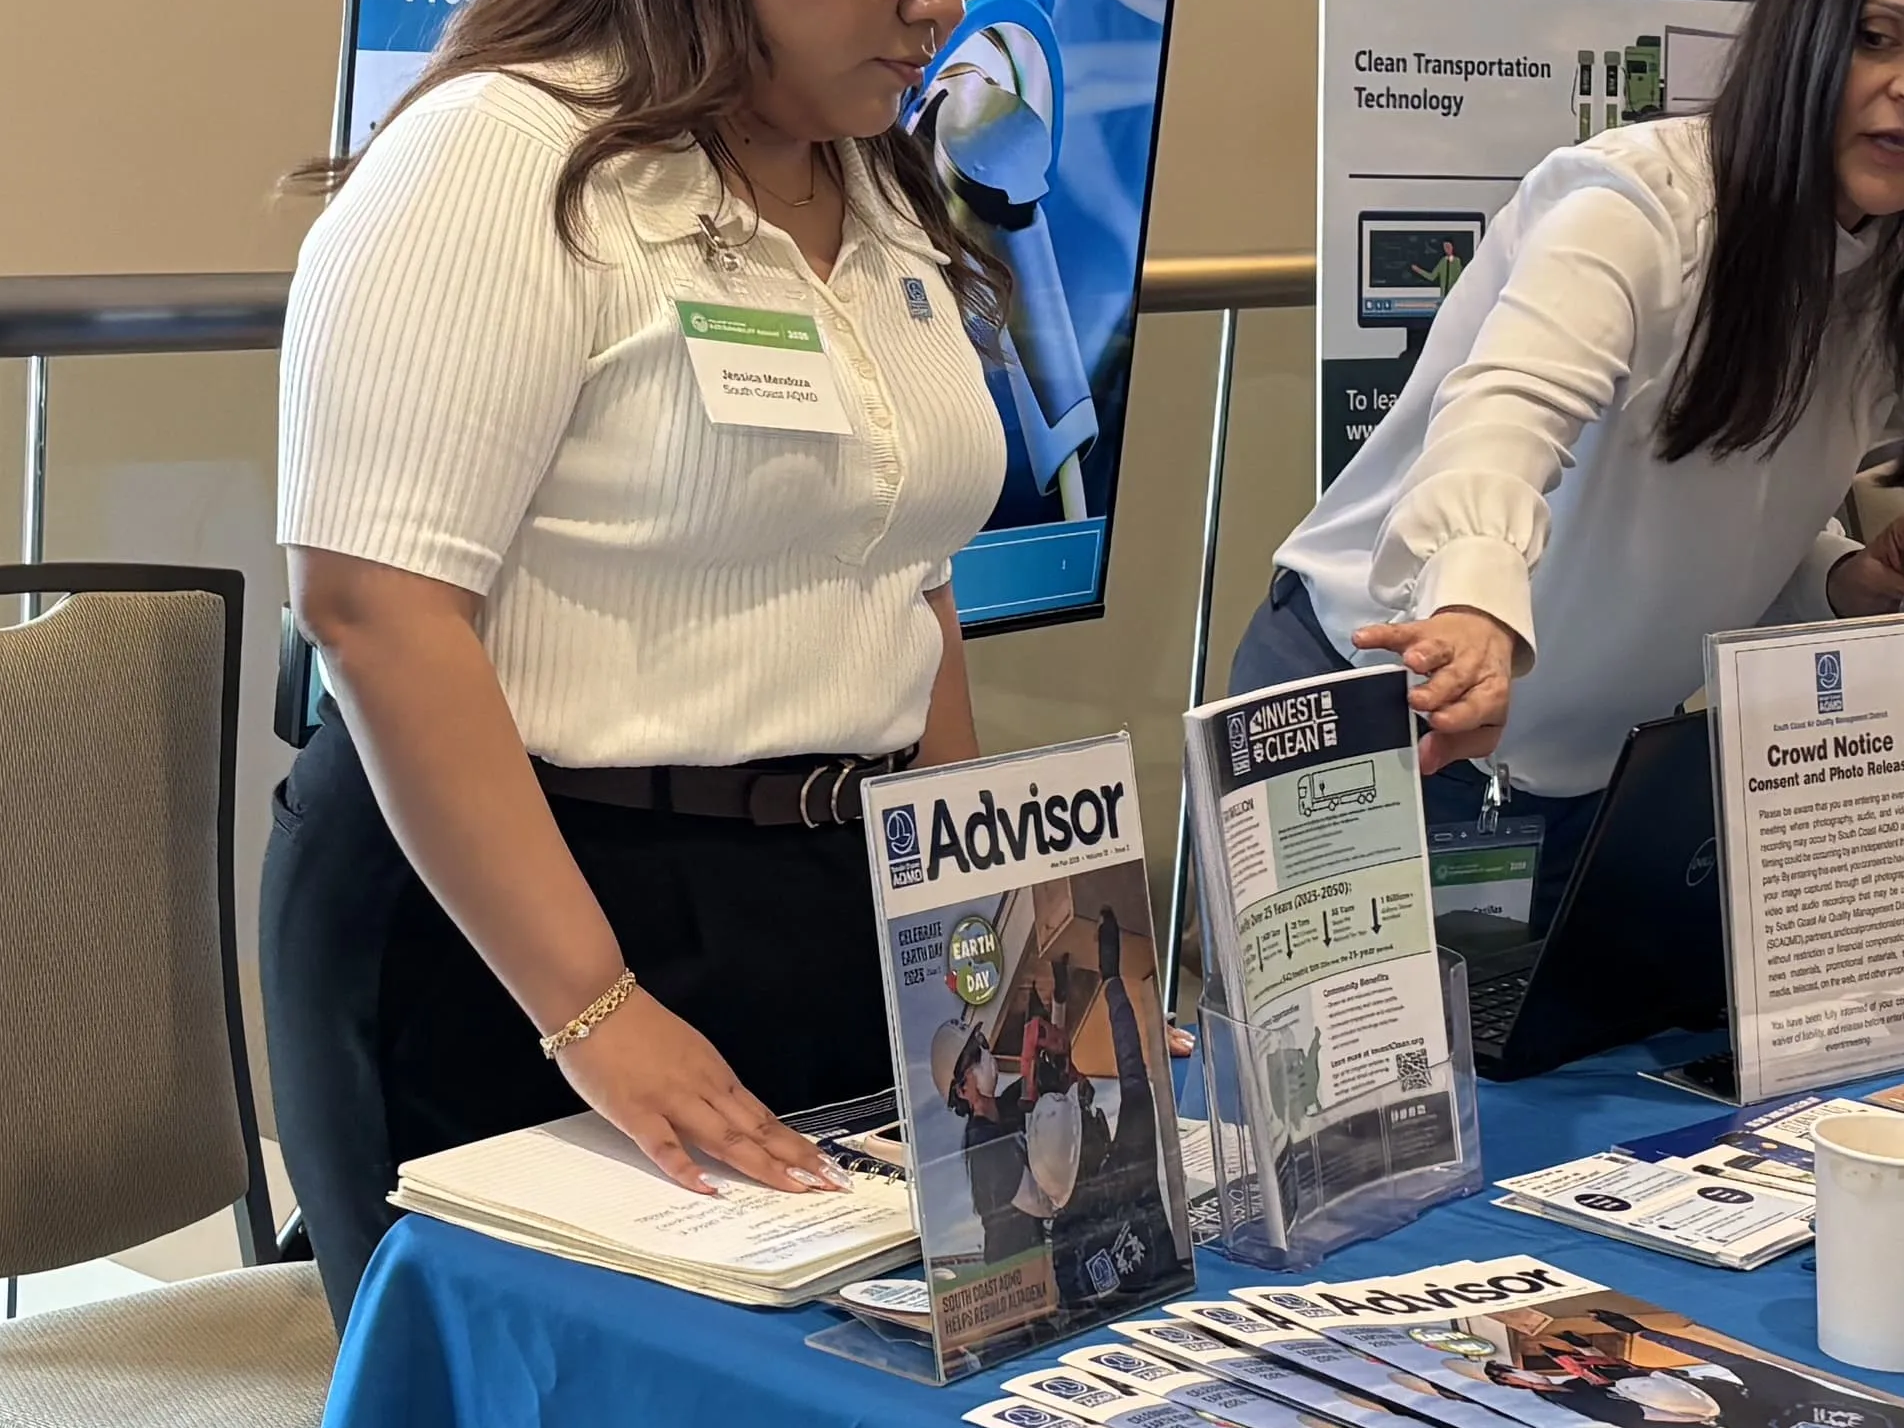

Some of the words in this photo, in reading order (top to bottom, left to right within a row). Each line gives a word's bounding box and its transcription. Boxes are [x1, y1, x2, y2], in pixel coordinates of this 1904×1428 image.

[1354, 48, 1408, 73] Clean
[1412, 52, 1552, 81] Transportation
[1353, 85, 1464, 118] Technology
[722, 368, 763, 385] Jessica
[763, 372, 812, 389] Mendoza
[722, 383, 754, 398] South
[754, 386, 785, 402] Coast
[785, 390, 820, 404] AQMD
[1345, 389, 1367, 412] To
[1261, 692, 1320, 731] INVEST
[1264, 723, 1320, 764] CLEAN
[1766, 737, 1828, 768] Crowd
[1832, 733, 1894, 759] Notice
[1747, 771, 1800, 793] Consent
[1802, 767, 1826, 785] and
[1828, 764, 1864, 782] Photo
[926, 781, 1125, 881] Advisor
[897, 920, 943, 948] CELEBRATE
[951, 932, 997, 961] EARTH
[900, 944, 928, 968] EARTH
[927, 941, 944, 962] DAY
[965, 970, 992, 994] DAY
[942, 1287, 973, 1314] SOUTH
[972, 1278, 999, 1303] COAST
[1317, 1266, 1568, 1317] Advisor
[944, 1309, 975, 1336] HELPS
